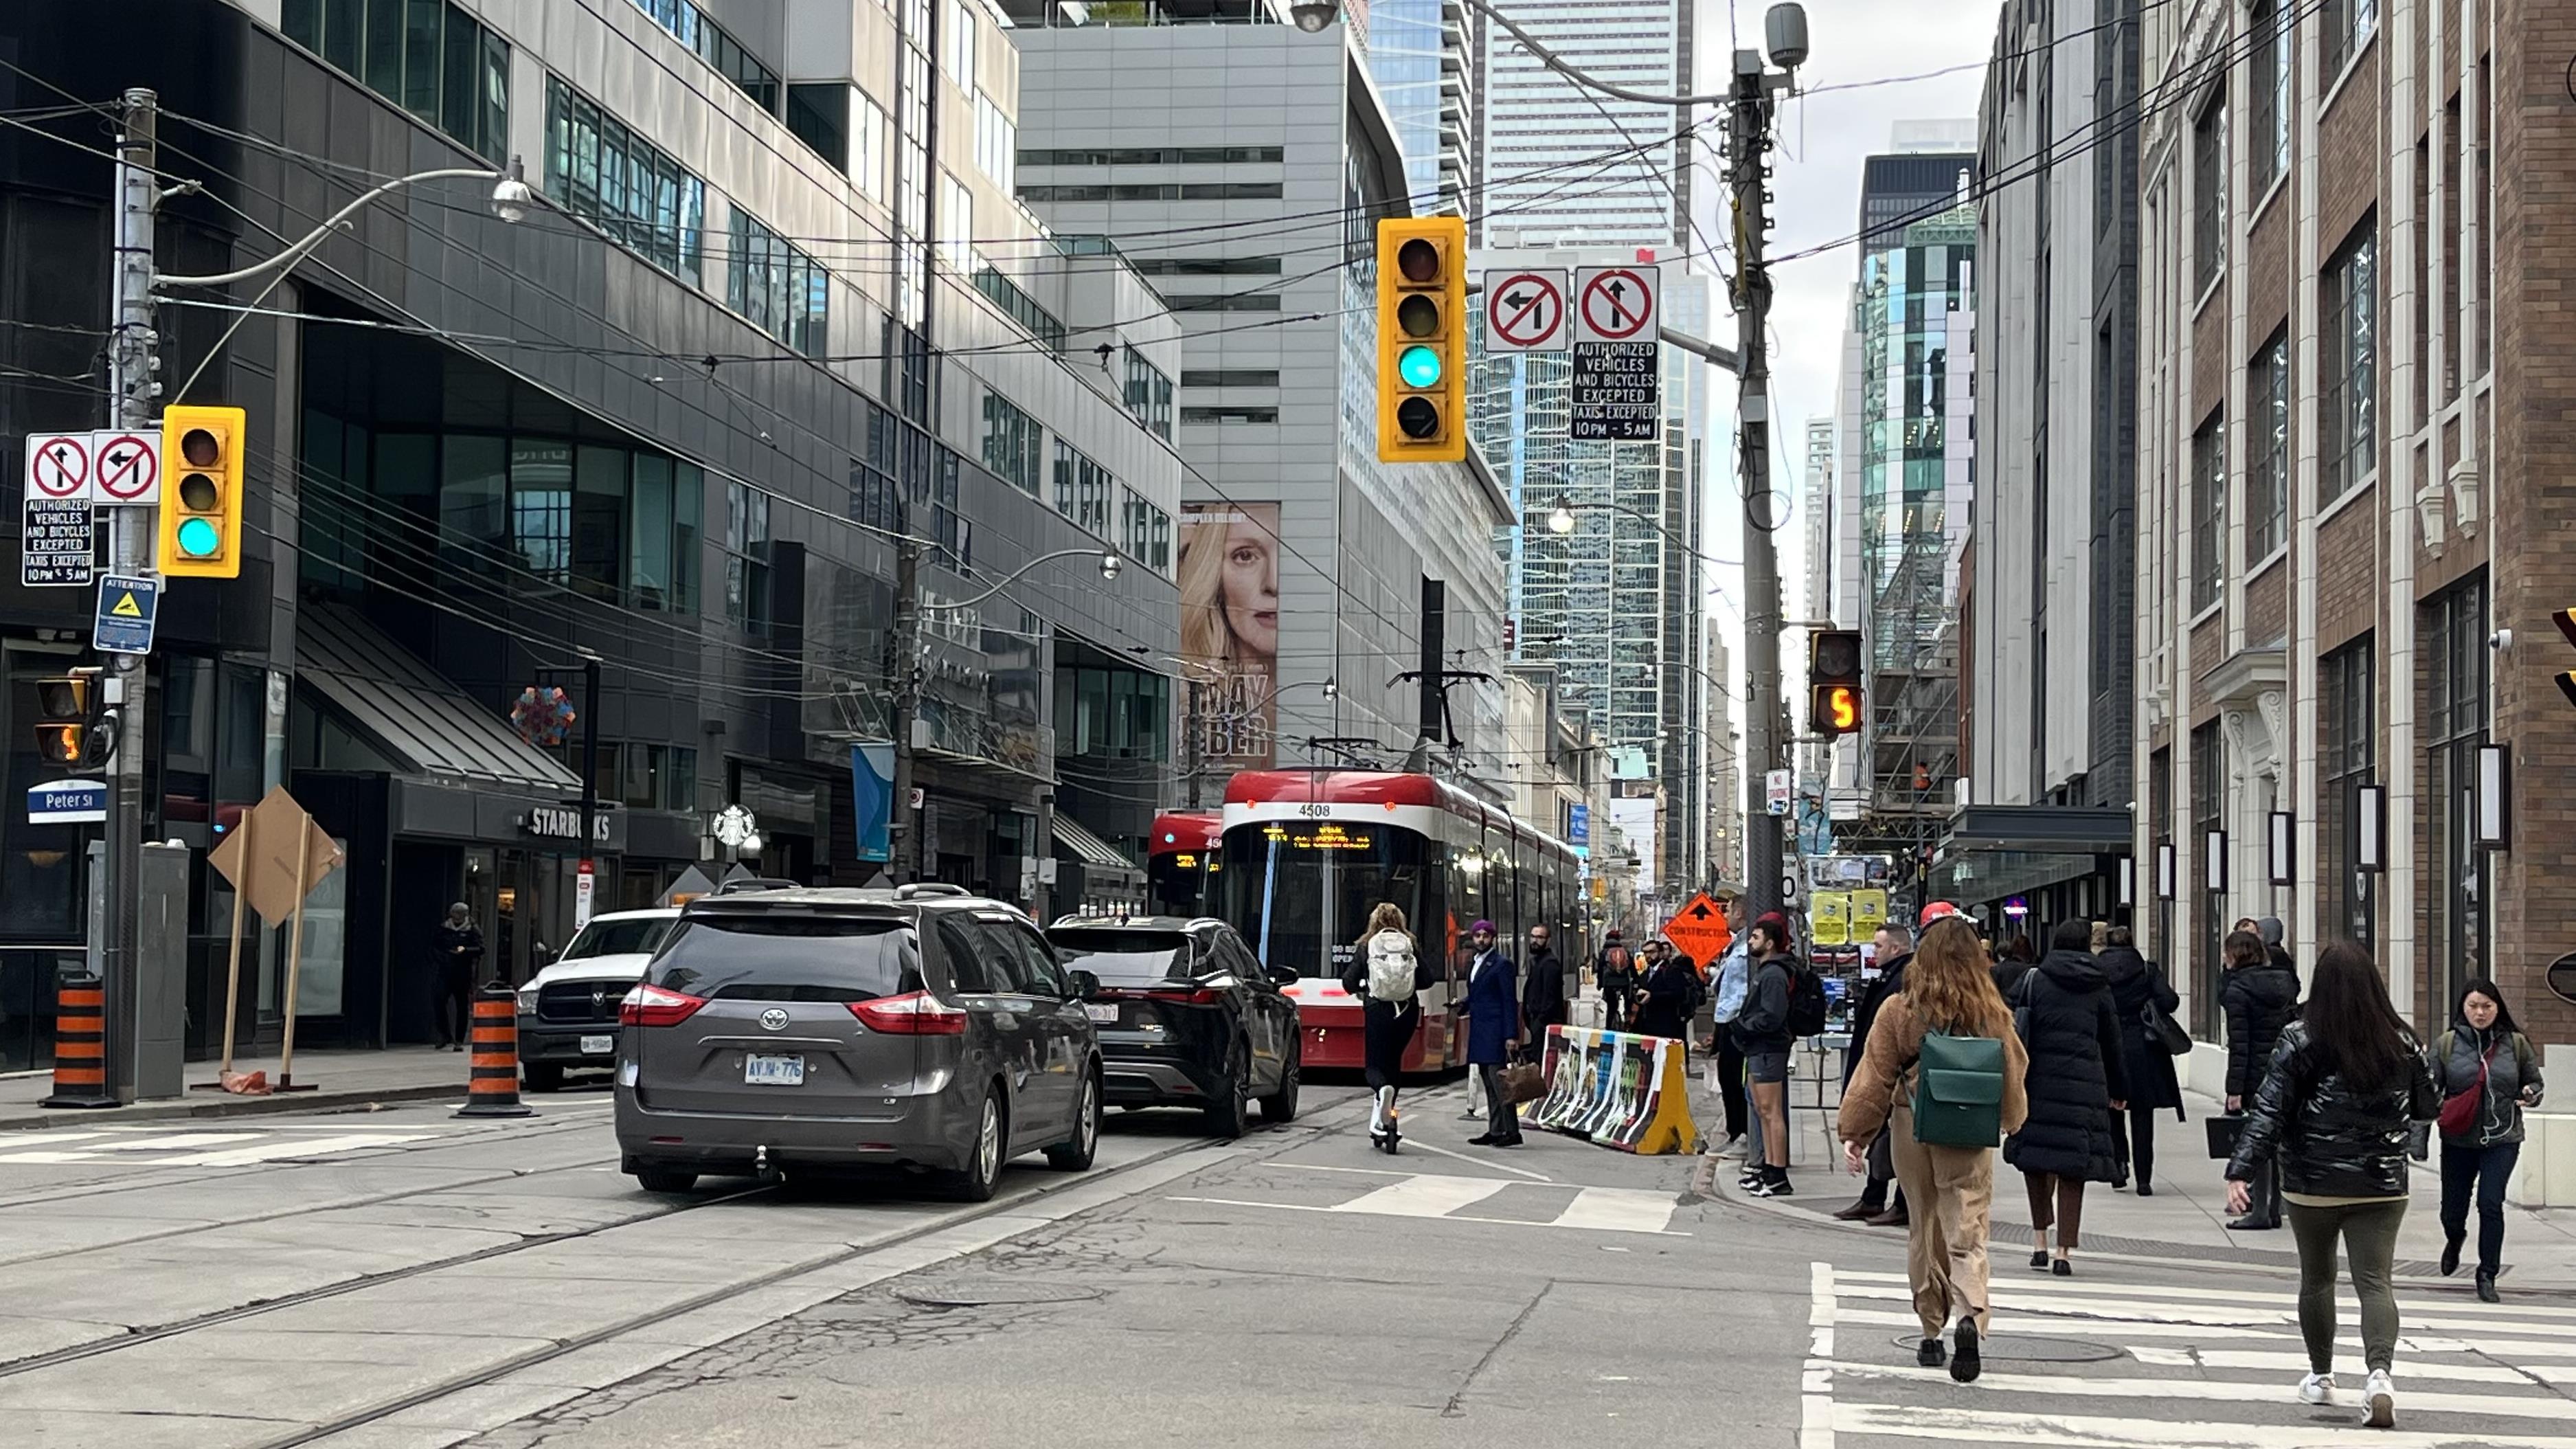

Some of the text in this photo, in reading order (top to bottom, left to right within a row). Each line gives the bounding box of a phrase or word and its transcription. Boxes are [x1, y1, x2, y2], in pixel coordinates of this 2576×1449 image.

[1577, 344, 1654, 356] AUTHORIZED
[1585, 359, 1645, 372] VEHICLES
[1574, 374, 1655, 387] AND BICYCLES
[1583, 389, 1645, 402] EXCEPTED
[1572, 406, 1655, 419] TAXIS EXCEPTED
[28, 499, 90, 511] AUTHORIZED
[34, 513, 83, 524] VEHICLES
[27, 526, 90, 537] AND BICYCLES
[33, 539, 84, 551] EXCEPTED
[25, 554, 91, 567] TAXIS EXCEPTED
[45, 794, 80, 809] Peter
[1299, 805, 1331, 817] 4508
[532, 807, 609, 841] STARBUKS
